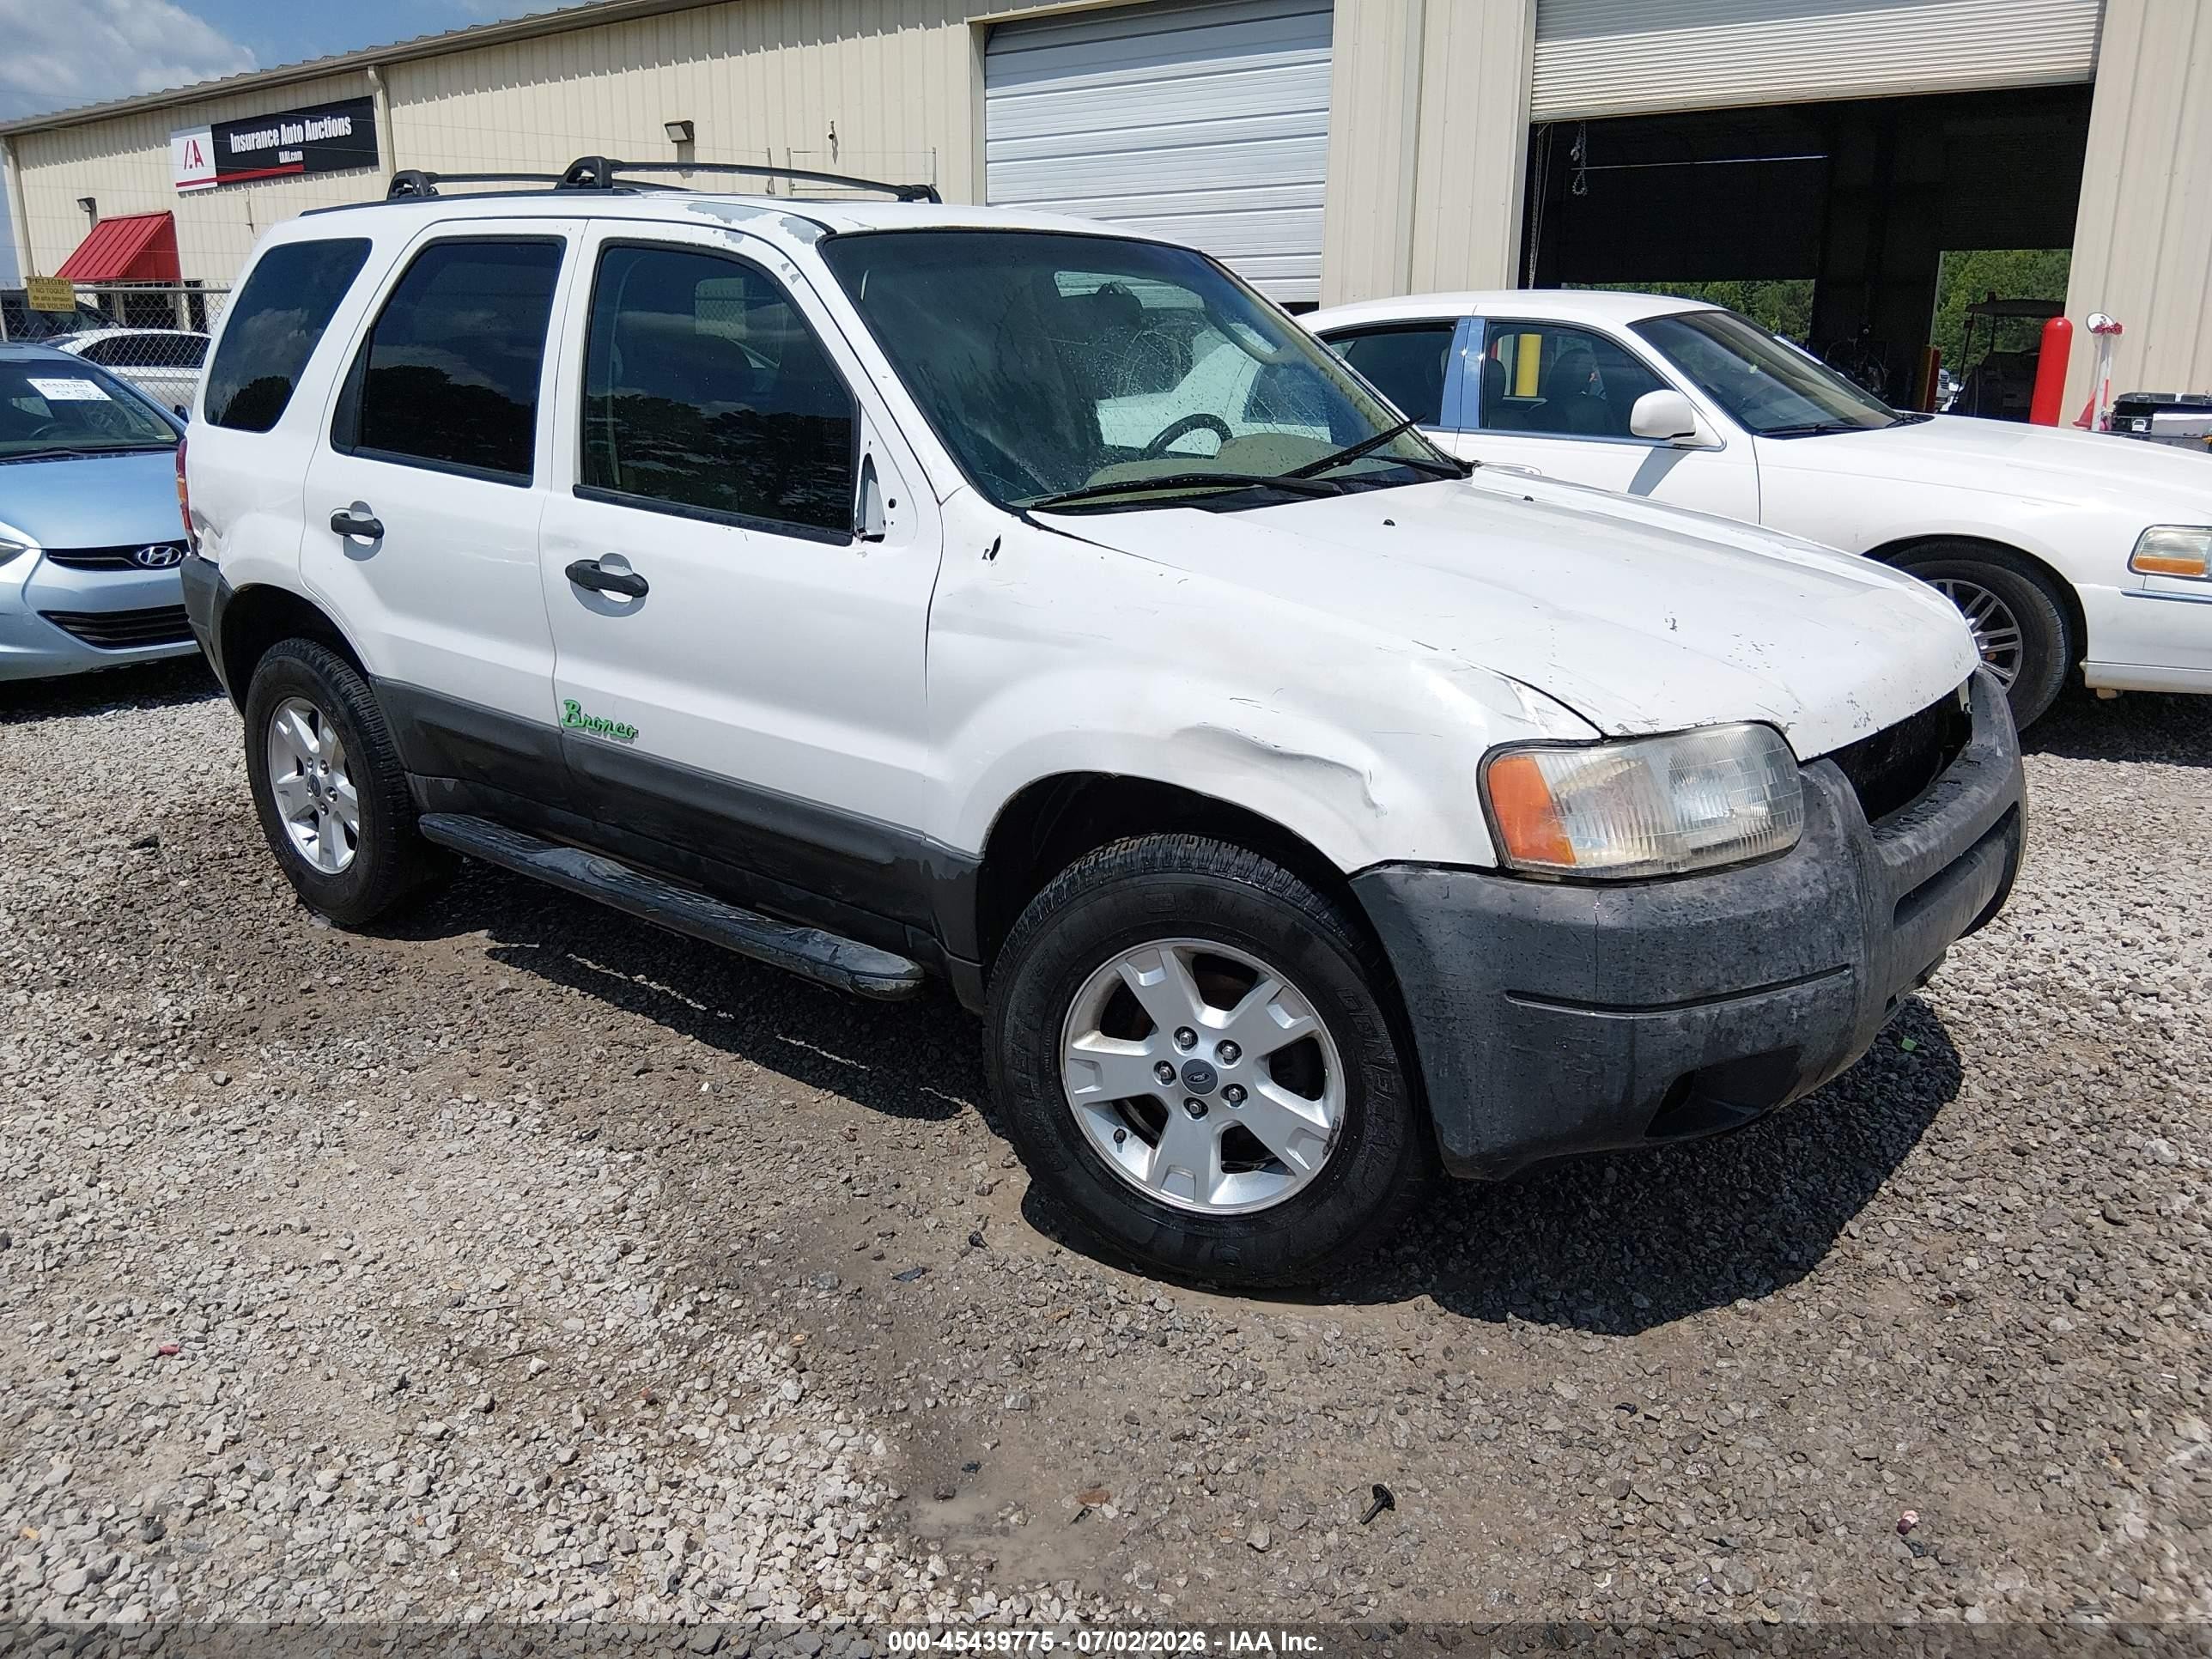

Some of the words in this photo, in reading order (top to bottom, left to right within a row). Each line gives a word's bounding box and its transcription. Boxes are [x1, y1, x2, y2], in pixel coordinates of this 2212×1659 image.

[230, 129, 280, 153] Insurance
[280, 123, 304, 145] Auto
[305, 116, 352, 142] Auctions
[562, 698, 639, 739] Bronco
